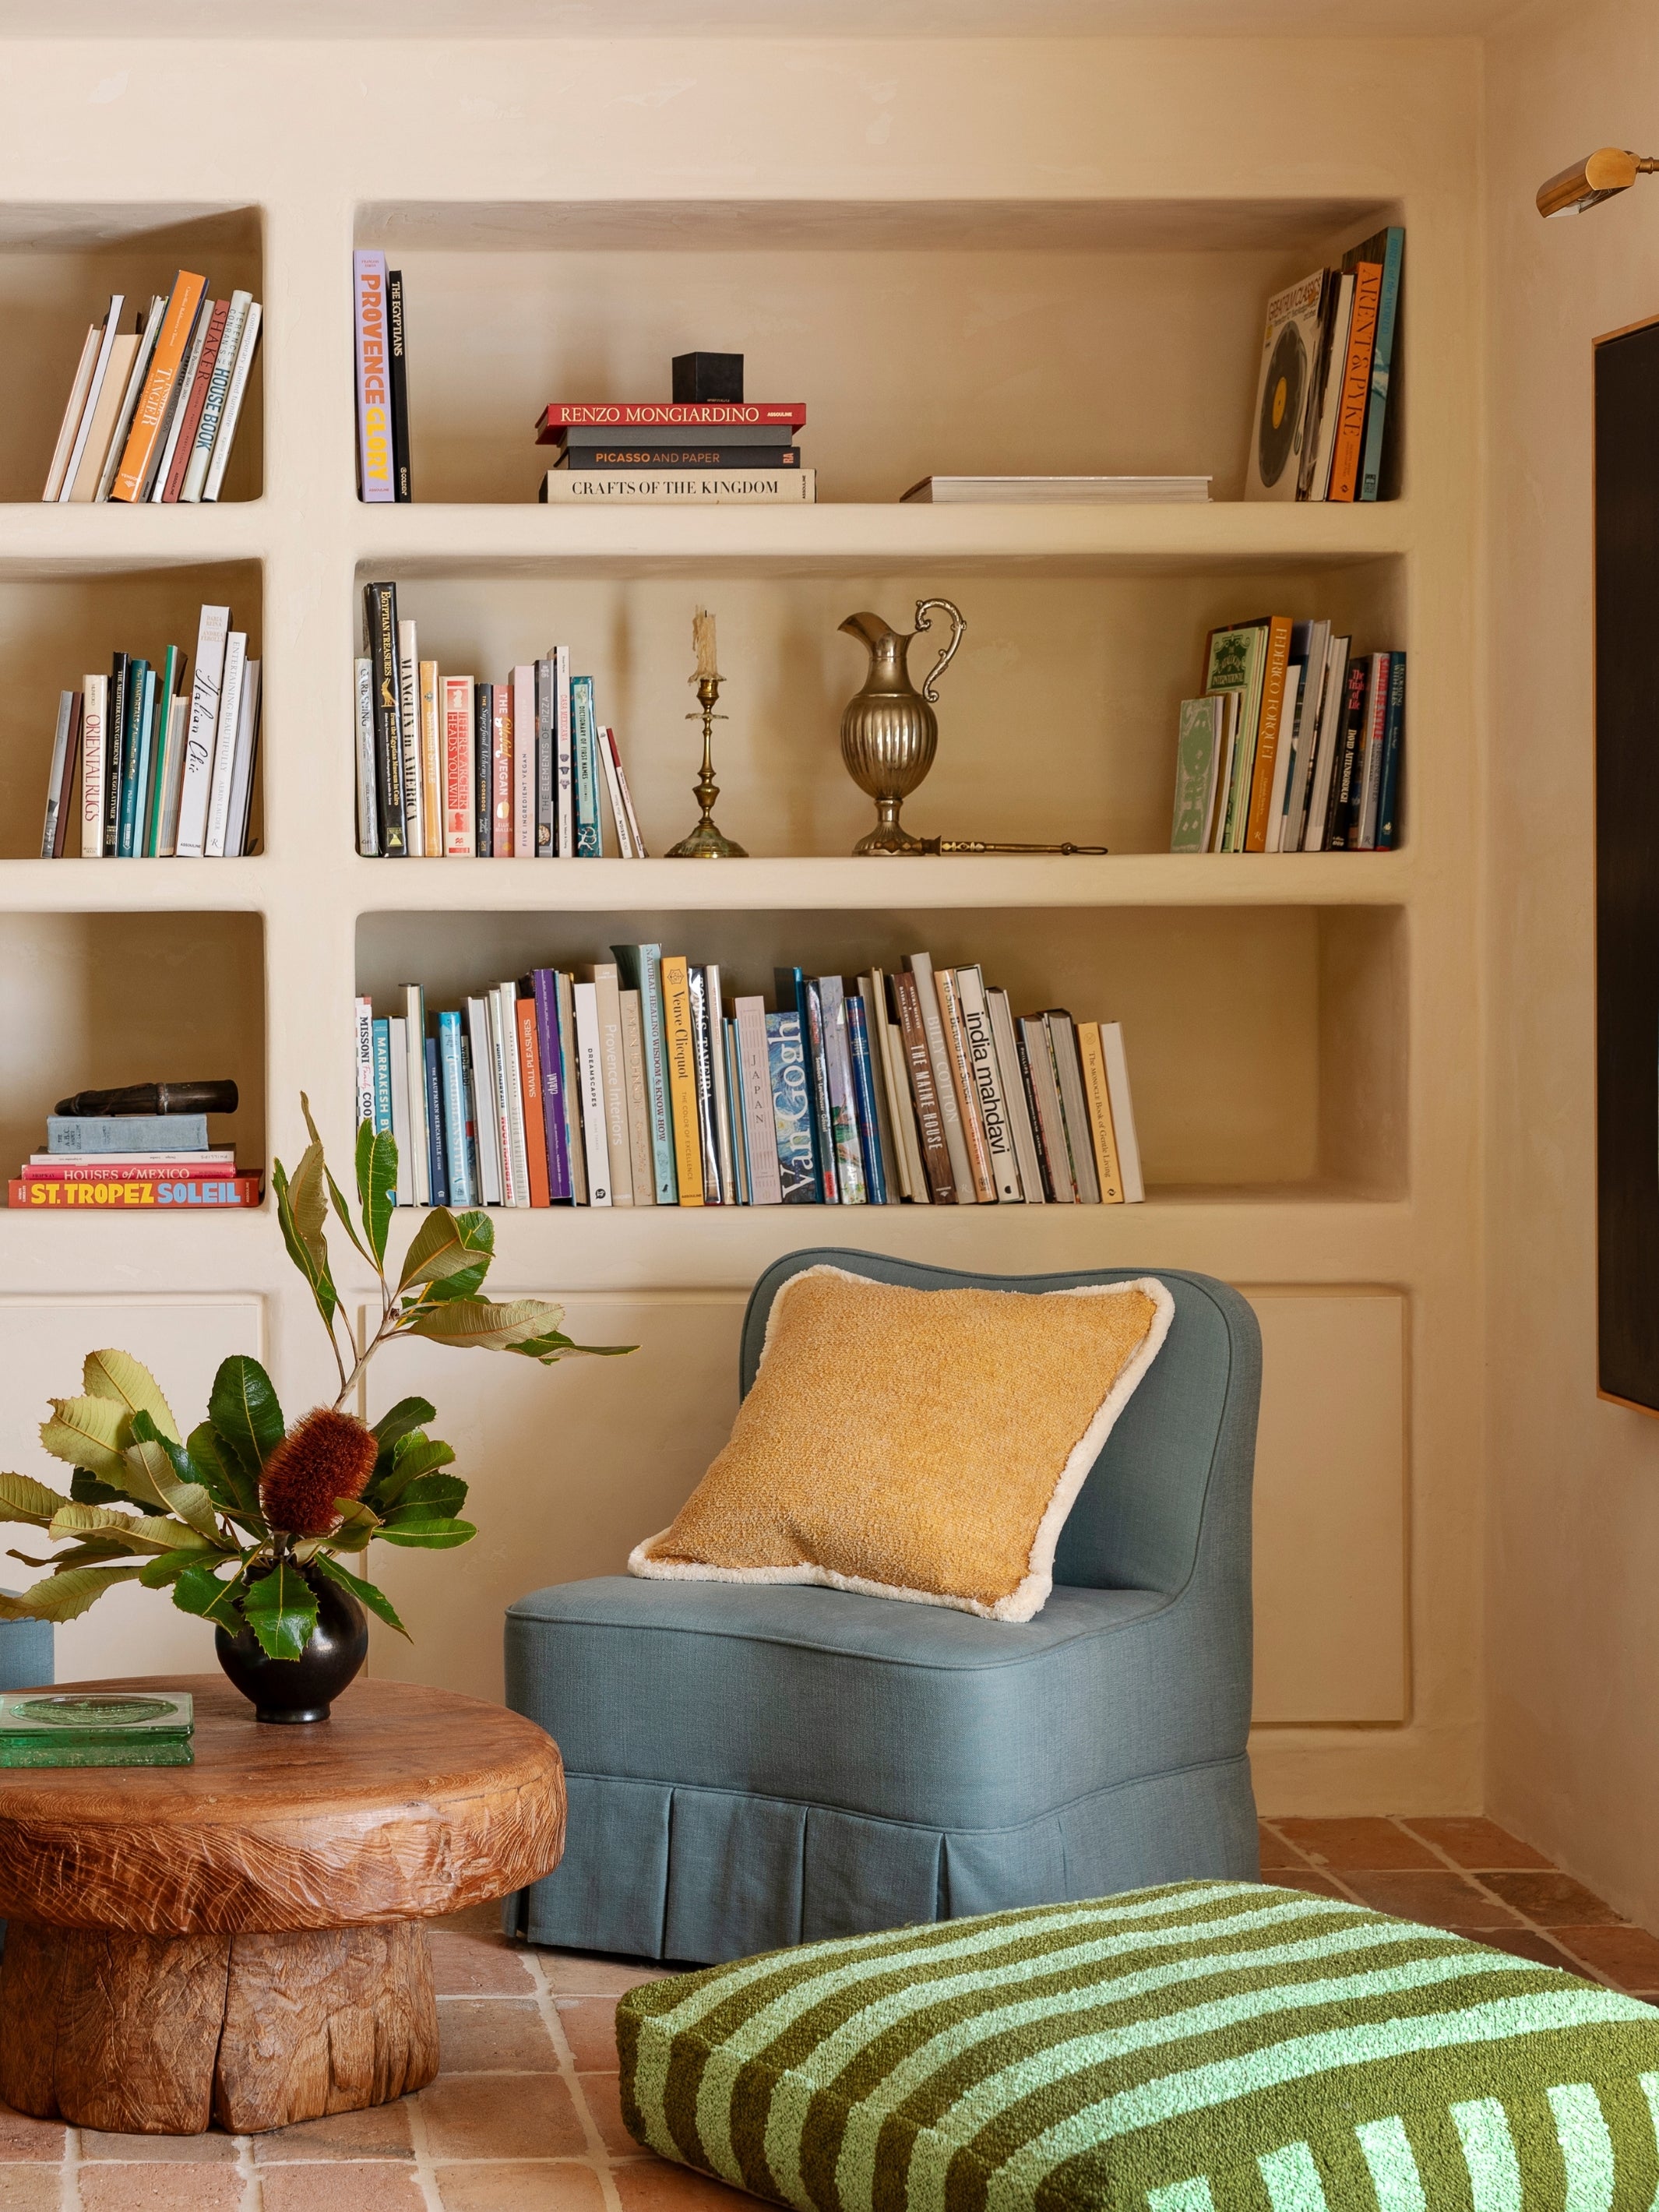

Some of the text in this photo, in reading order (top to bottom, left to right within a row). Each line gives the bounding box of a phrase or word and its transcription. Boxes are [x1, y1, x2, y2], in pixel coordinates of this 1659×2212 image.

[391, 281, 403, 356] THE EGYPTIANS
[1354, 268, 1379, 347] ARENT
[196, 308, 226, 382] SHAKER
[227, 310, 245, 357] TERENCE
[224, 312, 257, 427] contemporary painted furniture
[361, 273, 388, 481] PROVENCE GLORY
[1350, 354, 1368, 374] &
[140, 365, 173, 428] TANGIER
[195, 366, 231, 452] HOUSE BOOK
[561, 407, 759, 421] RENZO MONGIARDINO
[1342, 376, 1366, 437] PYKE
[596, 453, 720, 463] PICASSO AND PAPER
[169, 471, 179, 495] ASSOULINE
[572, 481, 778, 495] CRAFTS OF THE KINGDOM
[379, 590, 392, 676] EGYPTIAN TREASURES
[1268, 628, 1287, 694] FEDERICO
[1353, 669, 1365, 680] The
[114, 683, 122, 734] MEDITERRANEAN
[219, 640, 240, 771] ENTERTAINING BEAUTIFULLY
[498, 692, 508, 713] THE
[1348, 699, 1361, 710] Life
[1352, 690, 1360, 699] of
[188, 668, 220, 773] Italian Chic
[400, 657, 418, 821] MANGUIN in AMERICA
[479, 707, 488, 746] Superfood
[541, 727, 549, 739] OF
[559, 710, 568, 741] MEXICANA
[1258, 698, 1280, 762] FORQUET
[1372, 708, 1385, 740] STYLE
[83, 713, 101, 822] ORIENTAL RUGS
[426, 710, 436, 783] SPANISH STYLE
[448, 713, 458, 808] HEADS YOU WIN
[458, 712, 469, 806] JEFFREY ARCHER
[479, 747, 488, 779] Alchemy
[1339, 728, 1356, 802] DAVID ATTENBOROUGH
[498, 758, 508, 795] VEGAN
[644, 948, 656, 993] NATURAL
[648, 995, 659, 1037] HEALING
[902, 1006, 911, 1033] BURWELL
[909, 985, 918, 1008] MAURA
[358, 1016, 370, 1062] MISSONI
[523, 1018, 537, 1097] SMALL PLEASURES
[650, 1038, 660, 1076] WISDOM
[671, 991, 690, 1079] Veuve Clicquot
[967, 1011, 988, 1062] india
[1088, 1051, 1097, 1065] The
[360, 1065, 372, 1091] Family
[376, 1037, 389, 1112] MARRAKESH
[546, 1073, 558, 1094] CABANA
[586, 1048, 597, 1107] DREAMSCAPES
[926, 1015, 959, 1123] BILLY COTTON
[1019, 1047, 1029, 1074] PHILLIPS
[1090, 1066, 1101, 1101] MONOCLE
[604, 1024, 623, 1145] Provence Interiors
[750, 1055, 764, 1124] JAPAN
[910, 1043, 942, 1150] THE MAINE HOUSE
[653, 1087, 665, 1141] KNOW-HOW
[768, 1019, 815, 1197] Van Gogh
[977, 1066, 1011, 1155] mahdavi
[1094, 1101, 1104, 1120] Book
[683, 1129, 690, 1138] OF
[1099, 1129, 1109, 1154] Gentle
[64, 1170, 118, 1179] HOUSES
[122, 1168, 136, 1179] of
[136, 1168, 189, 1178] MEXICO
[684, 1139, 692, 1181] EXCELLENCE
[1100, 1154, 1111, 1178] Living
[31, 1182, 241, 1204] ST. TROPEZ SOLEIL
